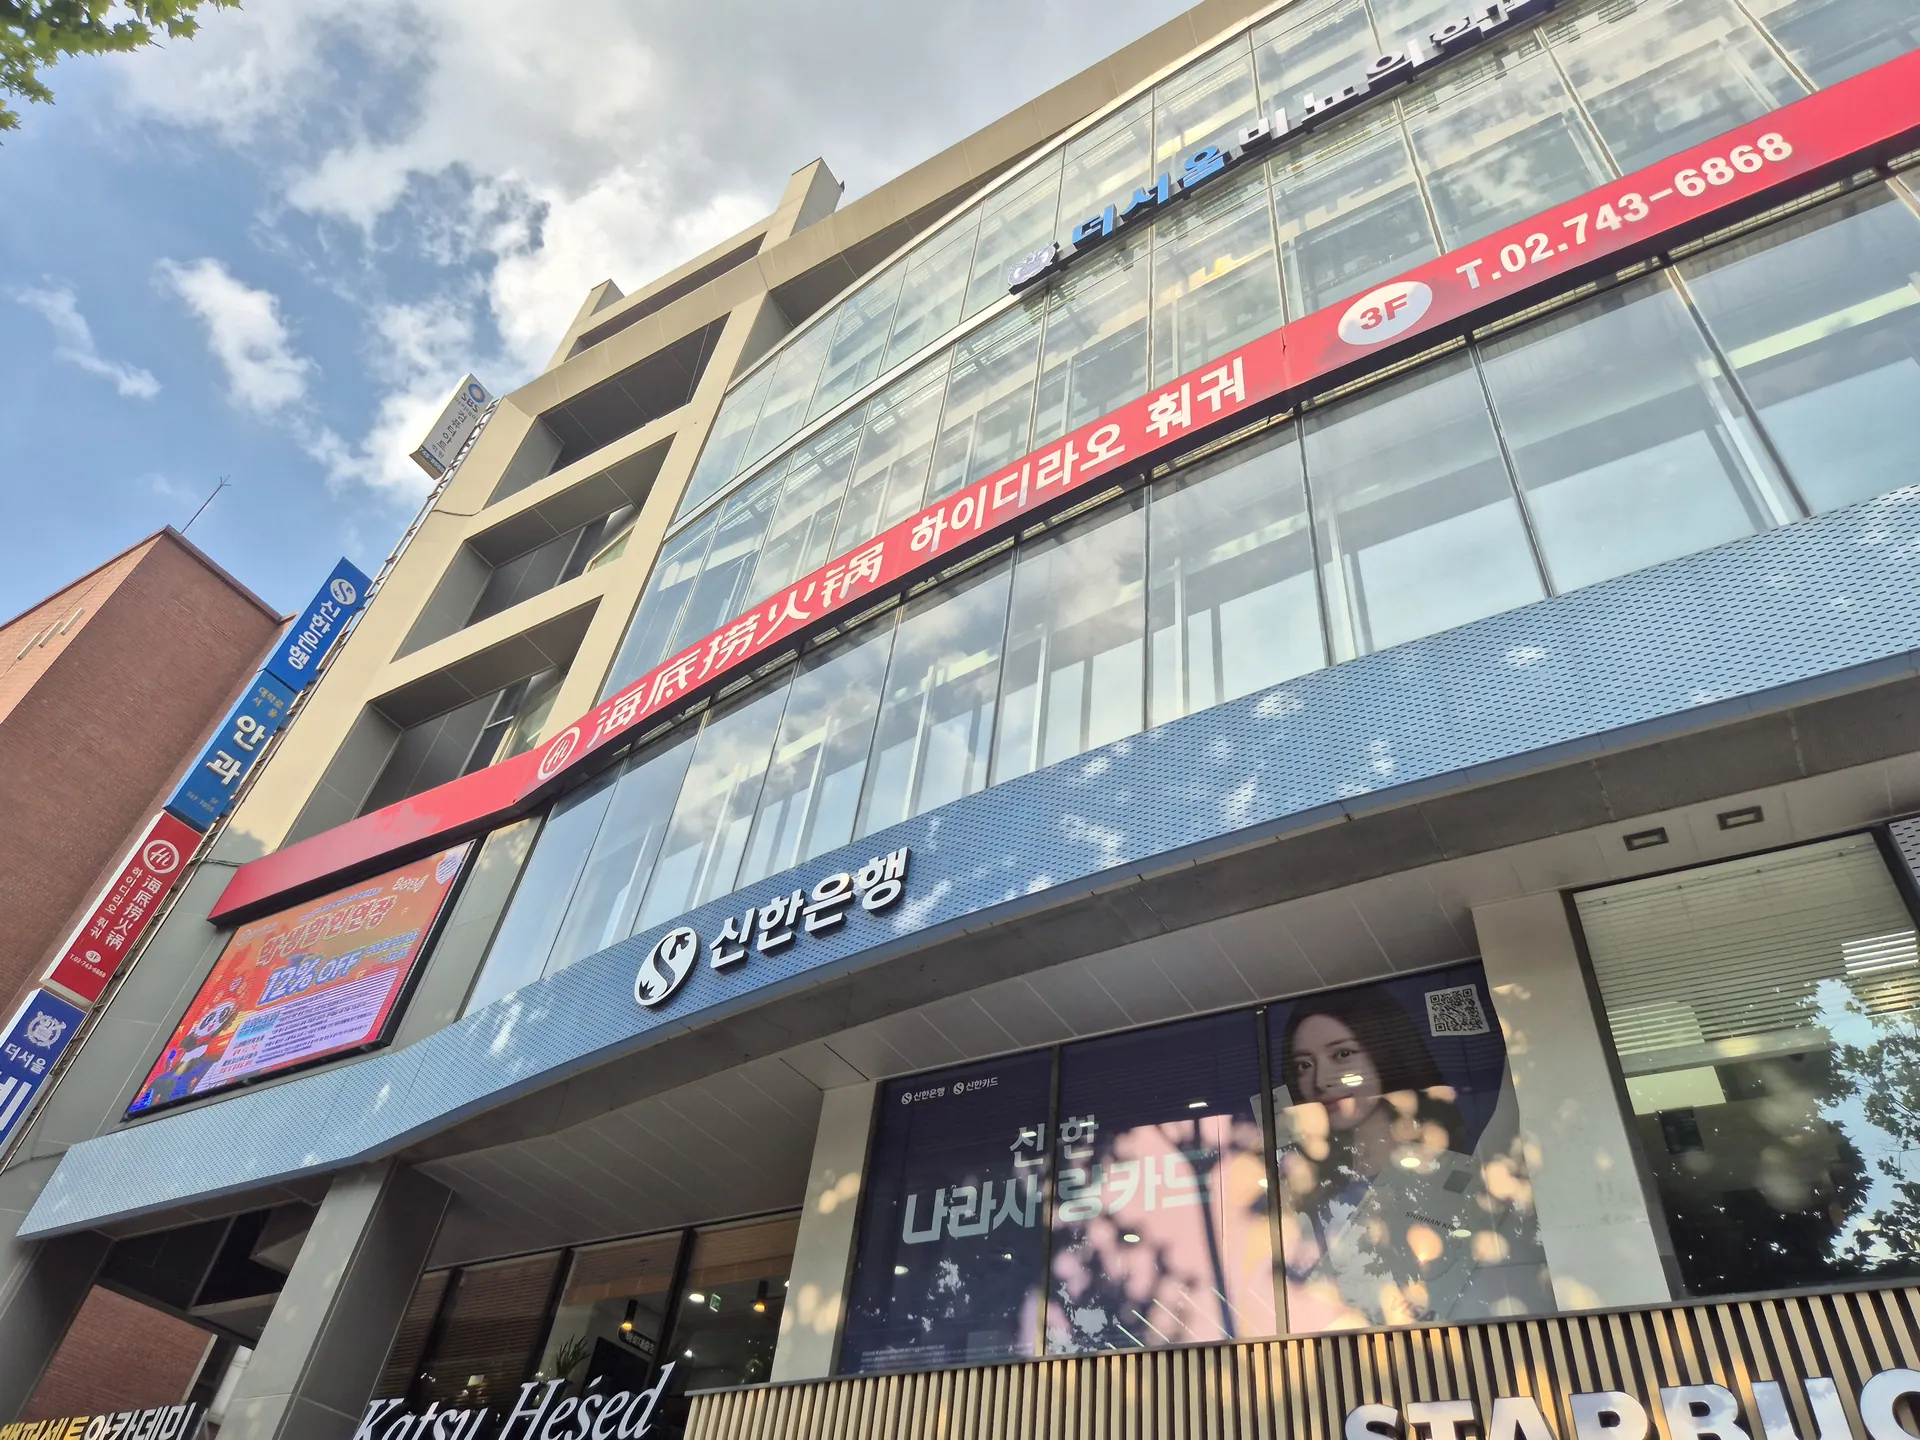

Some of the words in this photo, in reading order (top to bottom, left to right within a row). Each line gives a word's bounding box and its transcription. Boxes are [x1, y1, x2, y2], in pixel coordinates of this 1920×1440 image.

[1360, 293, 1409, 331] 3F
[461, 392, 480, 413] SBS
[910, 423, 1126, 553] 하이디라오
[1145, 356, 1246, 438] 훠궈
[288, 600, 341, 670] 신한은행
[587, 542, 884, 748] 海底捞火锅
[104, 866, 144, 915] 하이디라오
[104, 874, 164, 951] 海底捞火锅
[710, 847, 908, 969] 신한은행
[4, 1042, 47, 1075] 더서울
[913, 1087, 946, 1102] 신한은행
[965, 1076, 999, 1091] 신한카드
